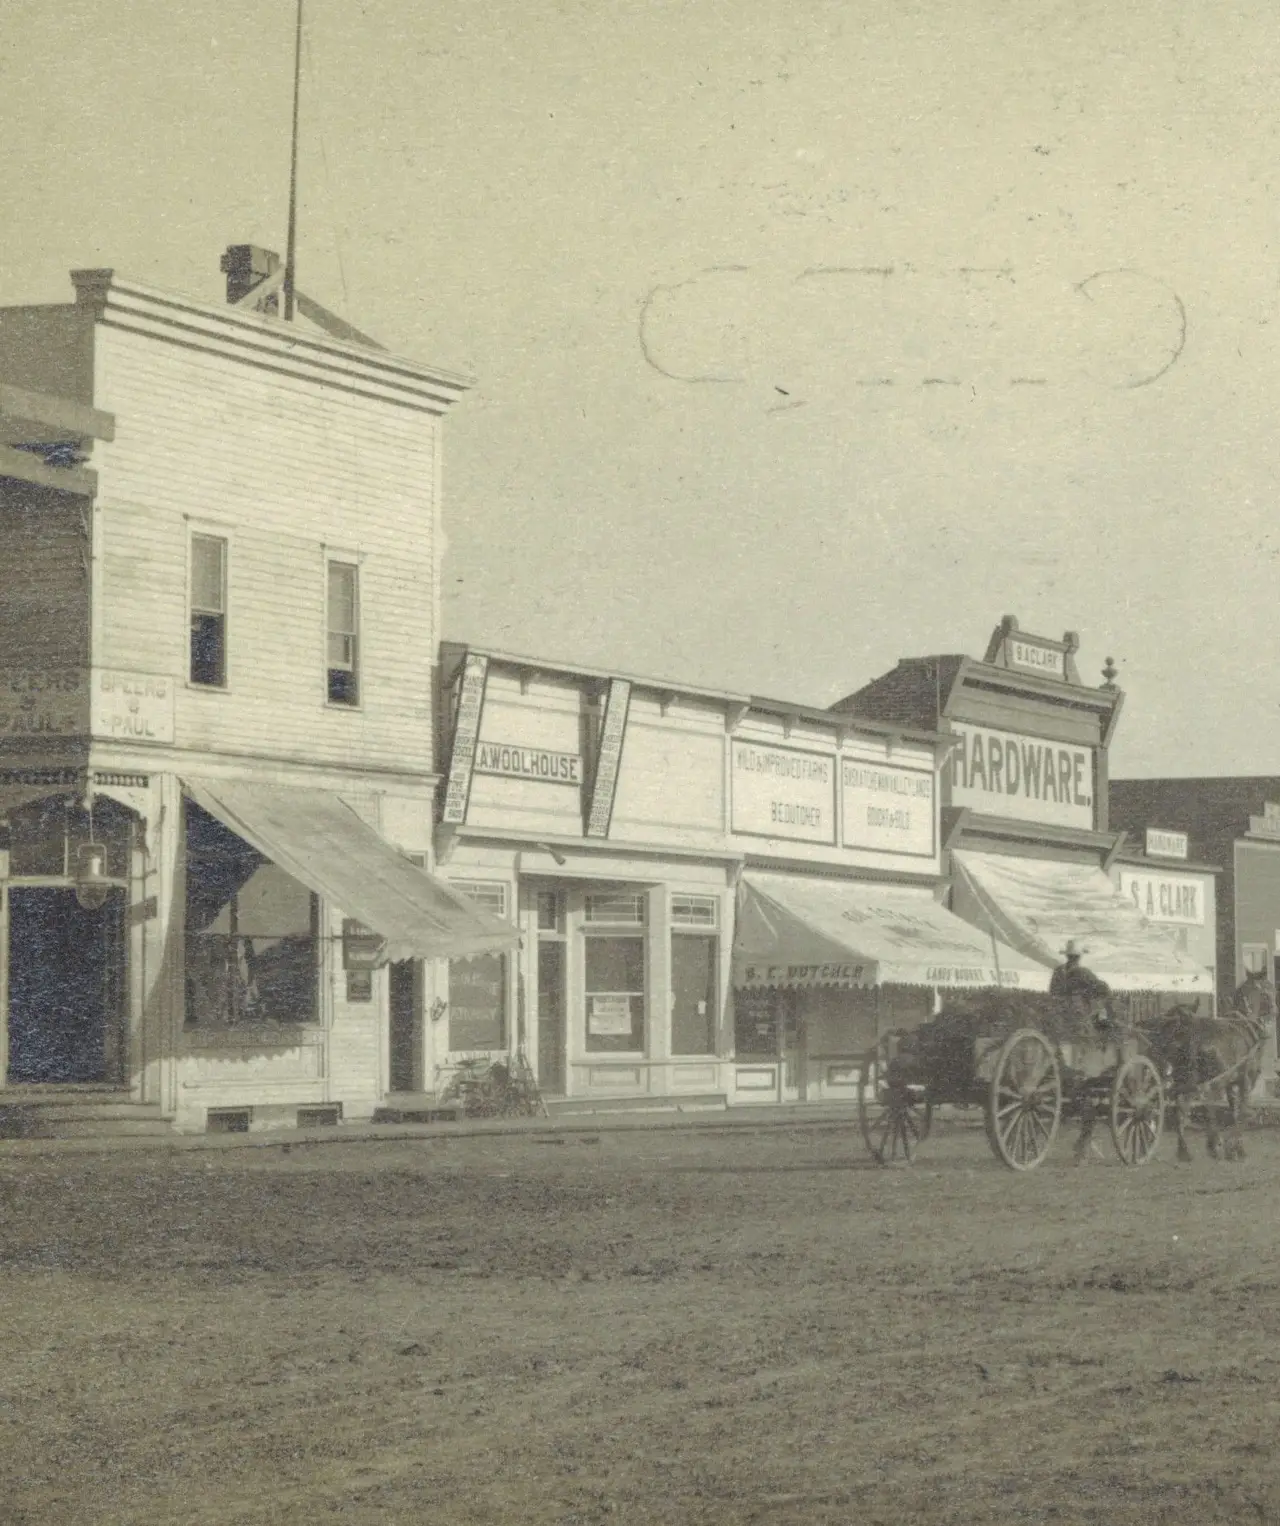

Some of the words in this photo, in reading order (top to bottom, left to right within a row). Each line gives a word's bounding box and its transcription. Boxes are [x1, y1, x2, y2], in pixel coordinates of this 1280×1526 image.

[100, 672, 167, 700] SPEERS
[112, 714, 156, 738] PAUL
[763, 754, 802, 780] IMPROVED
[803, 759, 828, 784] FARMS
[1160, 883, 1198, 919] CLARK
[786, 963, 865, 982] DUTCHER
